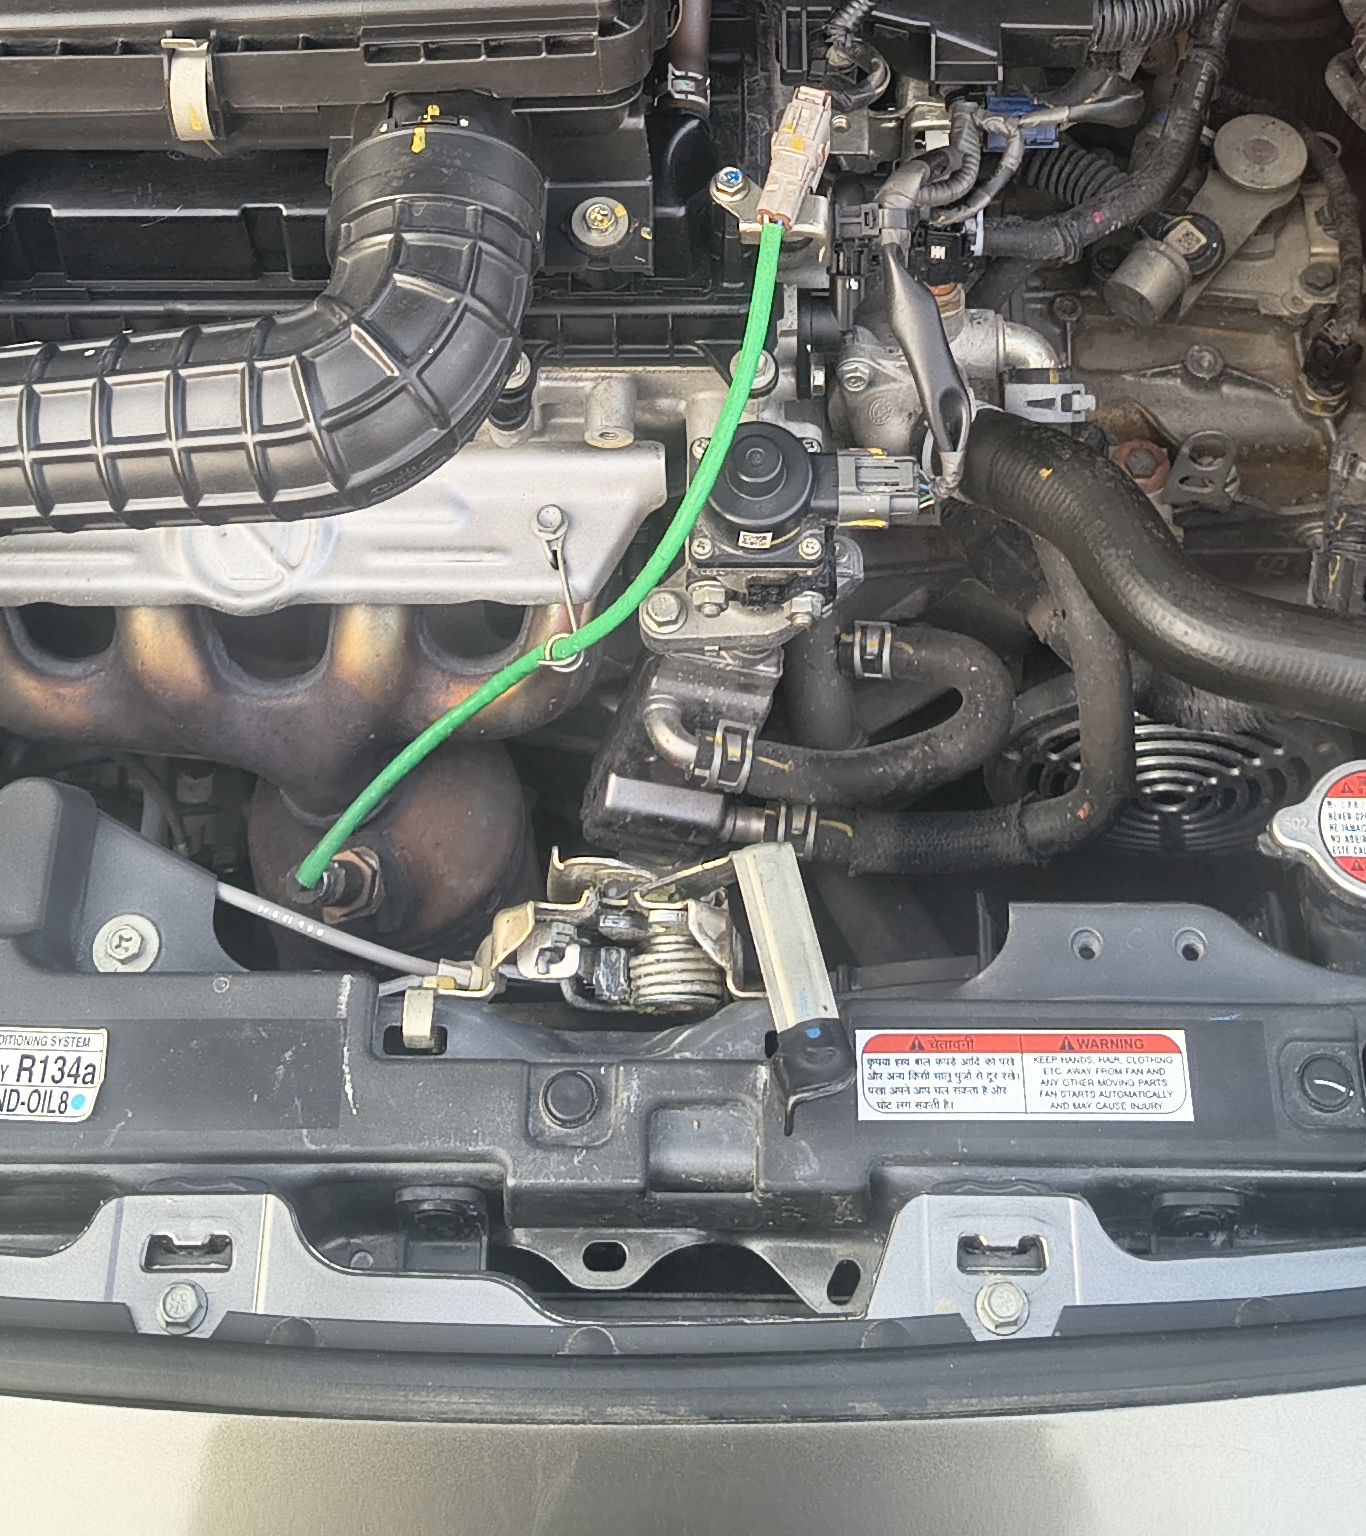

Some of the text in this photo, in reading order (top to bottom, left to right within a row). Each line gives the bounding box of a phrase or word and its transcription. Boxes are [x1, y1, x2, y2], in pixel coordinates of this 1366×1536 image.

[50, 1036, 91, 1048] SYSTEM
[928, 1035, 974, 1050] चेतावनी
[1076, 1037, 1145, 1050] WARNING
[1033, 1056, 1058, 1064] KEEP
[1126, 1056, 1174, 1064] CLOTHING
[16, 1054, 97, 1085] R134a
[1040, 1079, 1059, 1087] ANY
[1062, 1079, 1095, 1087] OTHER
[1097, 1079, 1135, 1087] MOVING
[1039, 1091, 1174, 1099] FAN STARTS AUTOMATICALLY
[1050, 1102, 1070, 1110] AND
[1072, 1102, 1093, 1110] MAY
[1095, 1102, 1128, 1110] CAUSE
